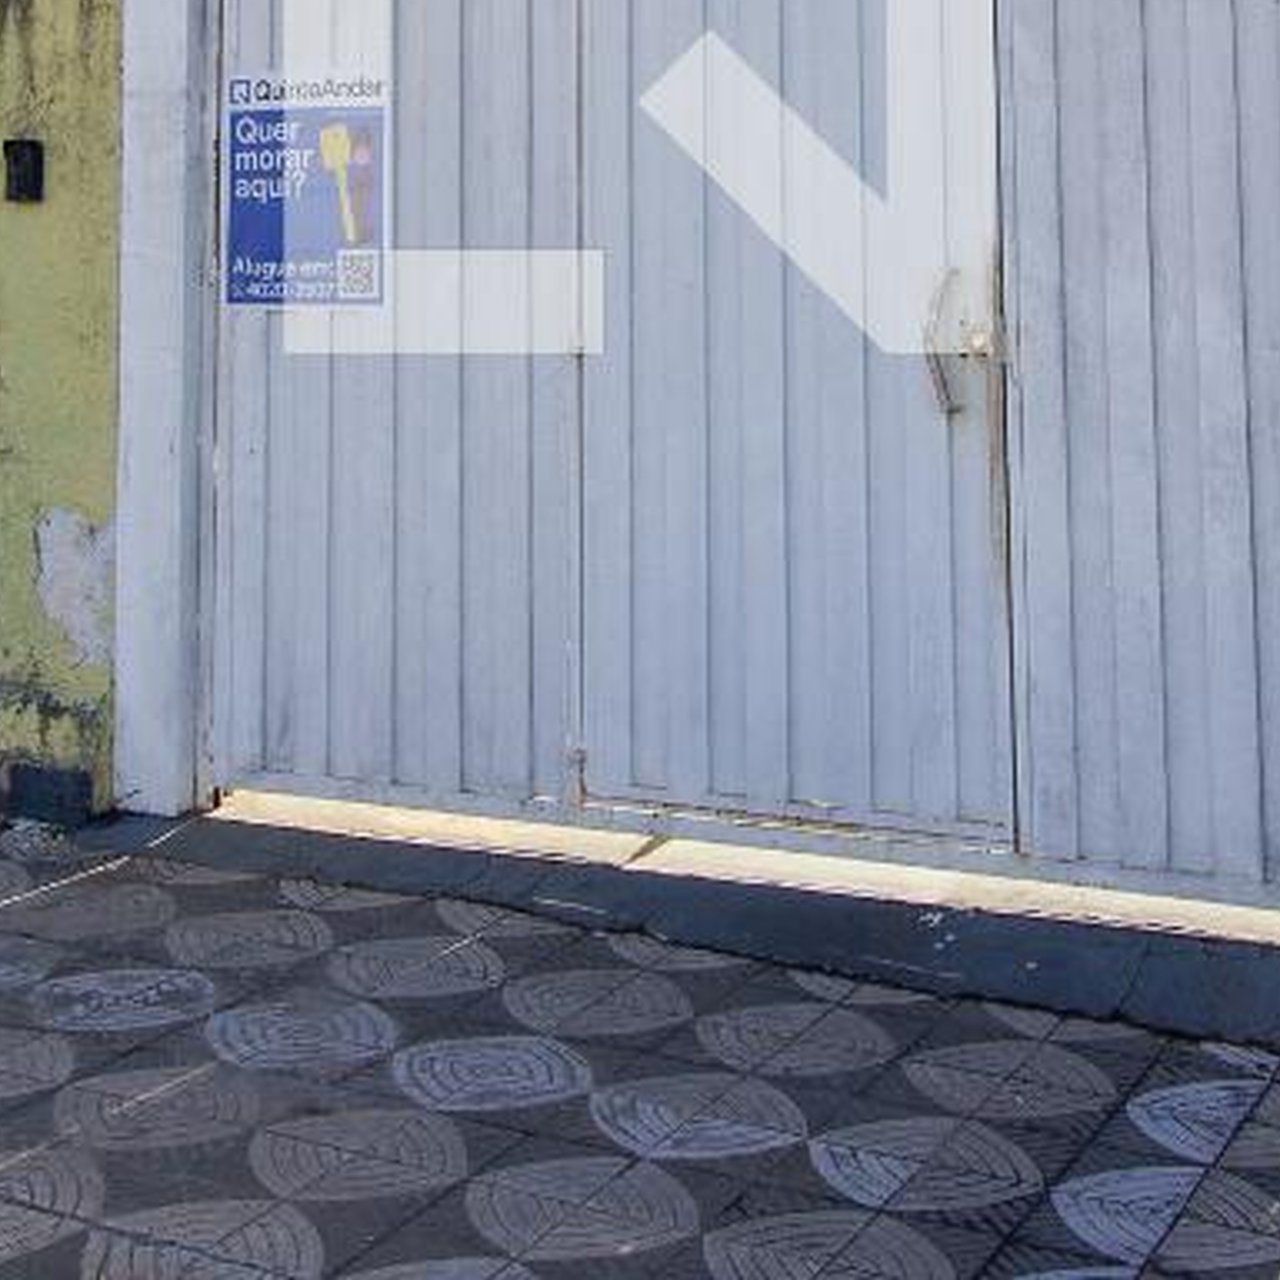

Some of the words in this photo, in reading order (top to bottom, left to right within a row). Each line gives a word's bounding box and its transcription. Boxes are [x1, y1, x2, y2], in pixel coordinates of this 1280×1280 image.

[236, 117, 301, 144] Quer
[235, 149, 314, 170] morar
[235, 172, 306, 203] aqui?
